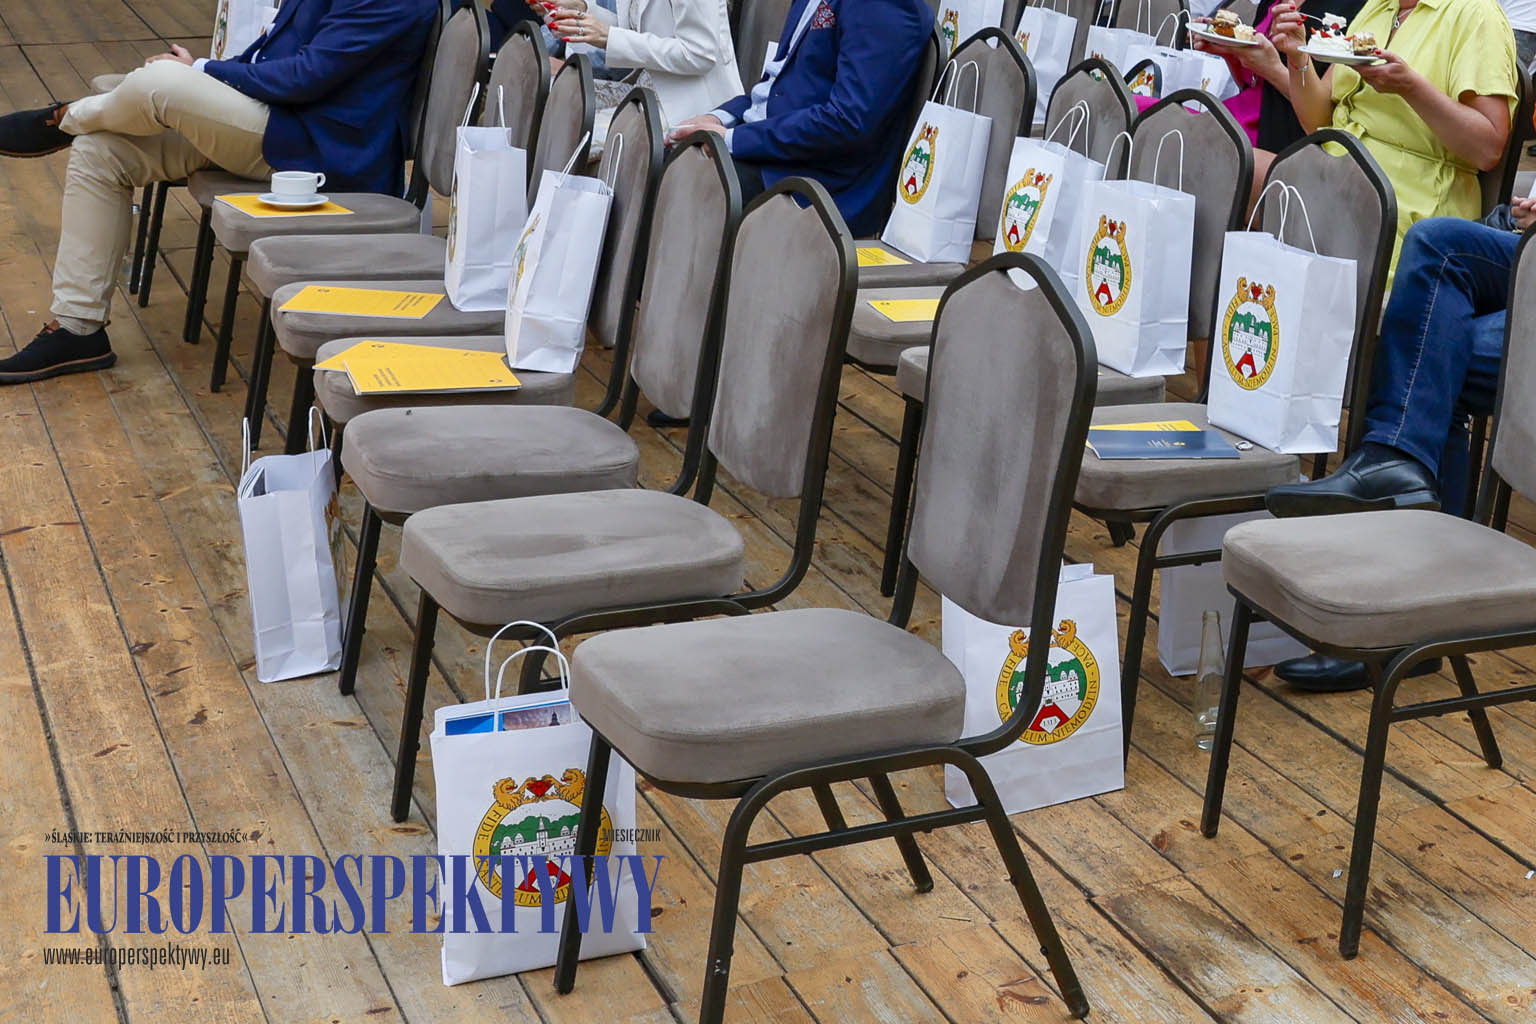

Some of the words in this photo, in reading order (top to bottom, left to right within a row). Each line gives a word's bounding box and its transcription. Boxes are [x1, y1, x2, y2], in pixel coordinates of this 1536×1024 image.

[1072, 642, 1095, 669] PACE
[999, 658, 1017, 687] FIDE
[1051, 680, 1097, 739] NIEMODLIN
[478, 809, 503, 841] FIDE
